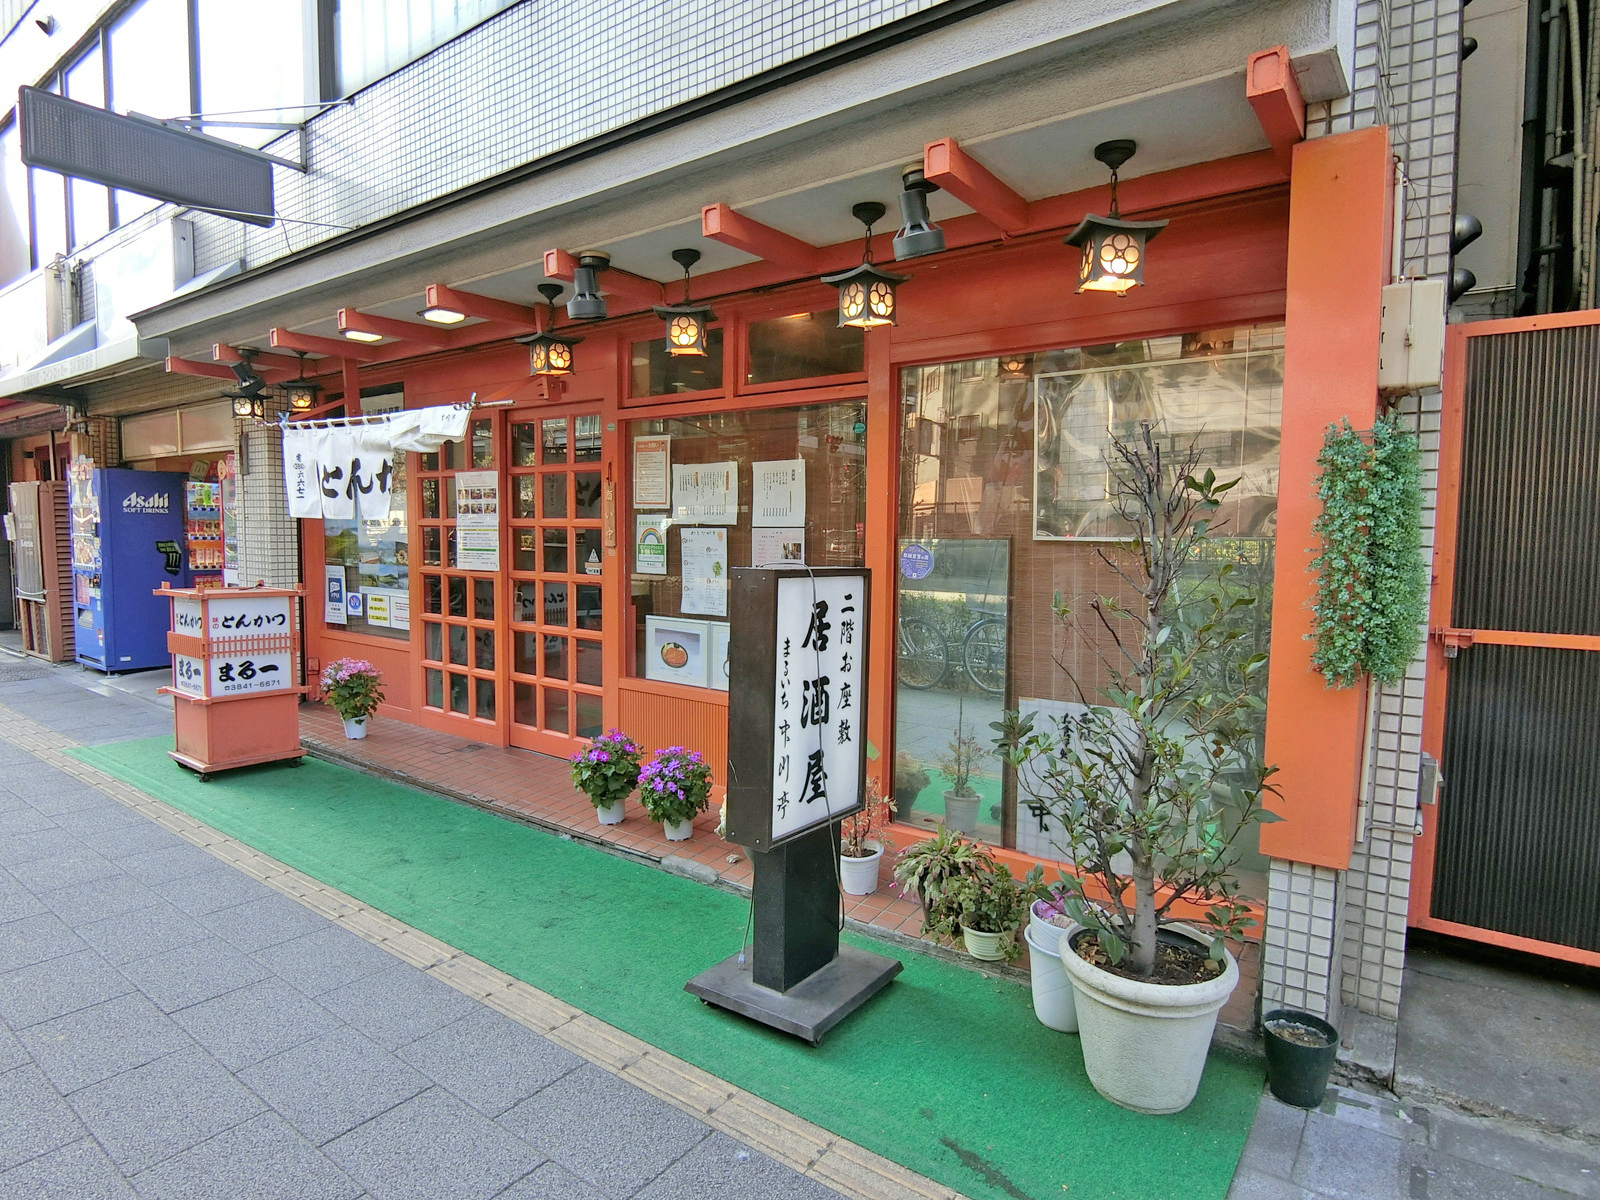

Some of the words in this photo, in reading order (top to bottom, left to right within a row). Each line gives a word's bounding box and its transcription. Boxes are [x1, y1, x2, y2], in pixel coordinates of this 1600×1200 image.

[122, 491, 169, 508] Asahi
[179, 612, 202, 630] とんかつ
[221, 613, 286, 630] とんかつ
[837, 594, 855, 745] 二階お座敷
[799, 600, 832, 805] 居酒屋
